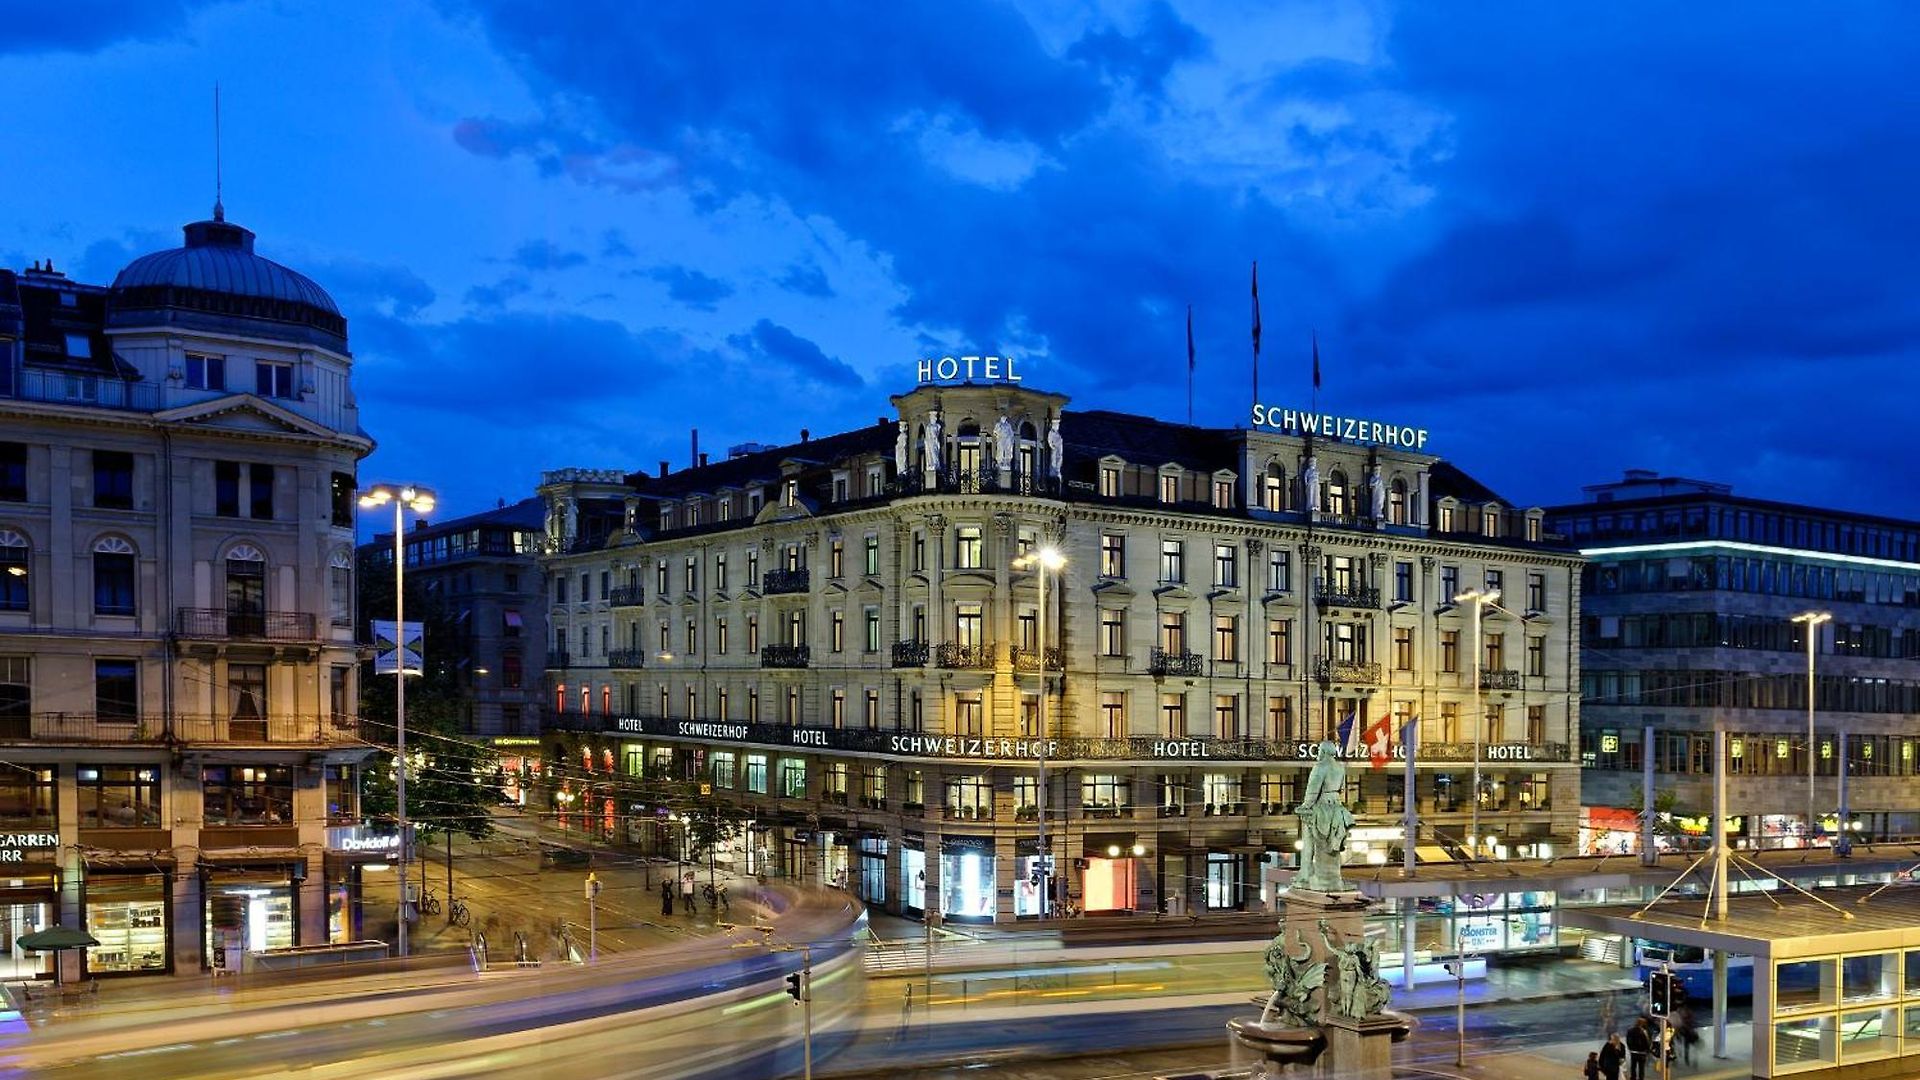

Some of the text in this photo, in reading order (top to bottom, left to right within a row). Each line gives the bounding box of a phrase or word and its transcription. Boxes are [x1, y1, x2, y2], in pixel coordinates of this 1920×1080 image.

[918, 356, 1022, 382] HOTEL
[1252, 404, 1428, 448] SCHWEIZERHOF
[618, 718, 828, 745] HOTEL SCHWEIZERHOF HOTEL
[891, 736, 1210, 757] SCHWEIZERHOF HOTEL
[1488, 746, 1531, 759] HOTEL
[0, 849, 23, 862] RR
